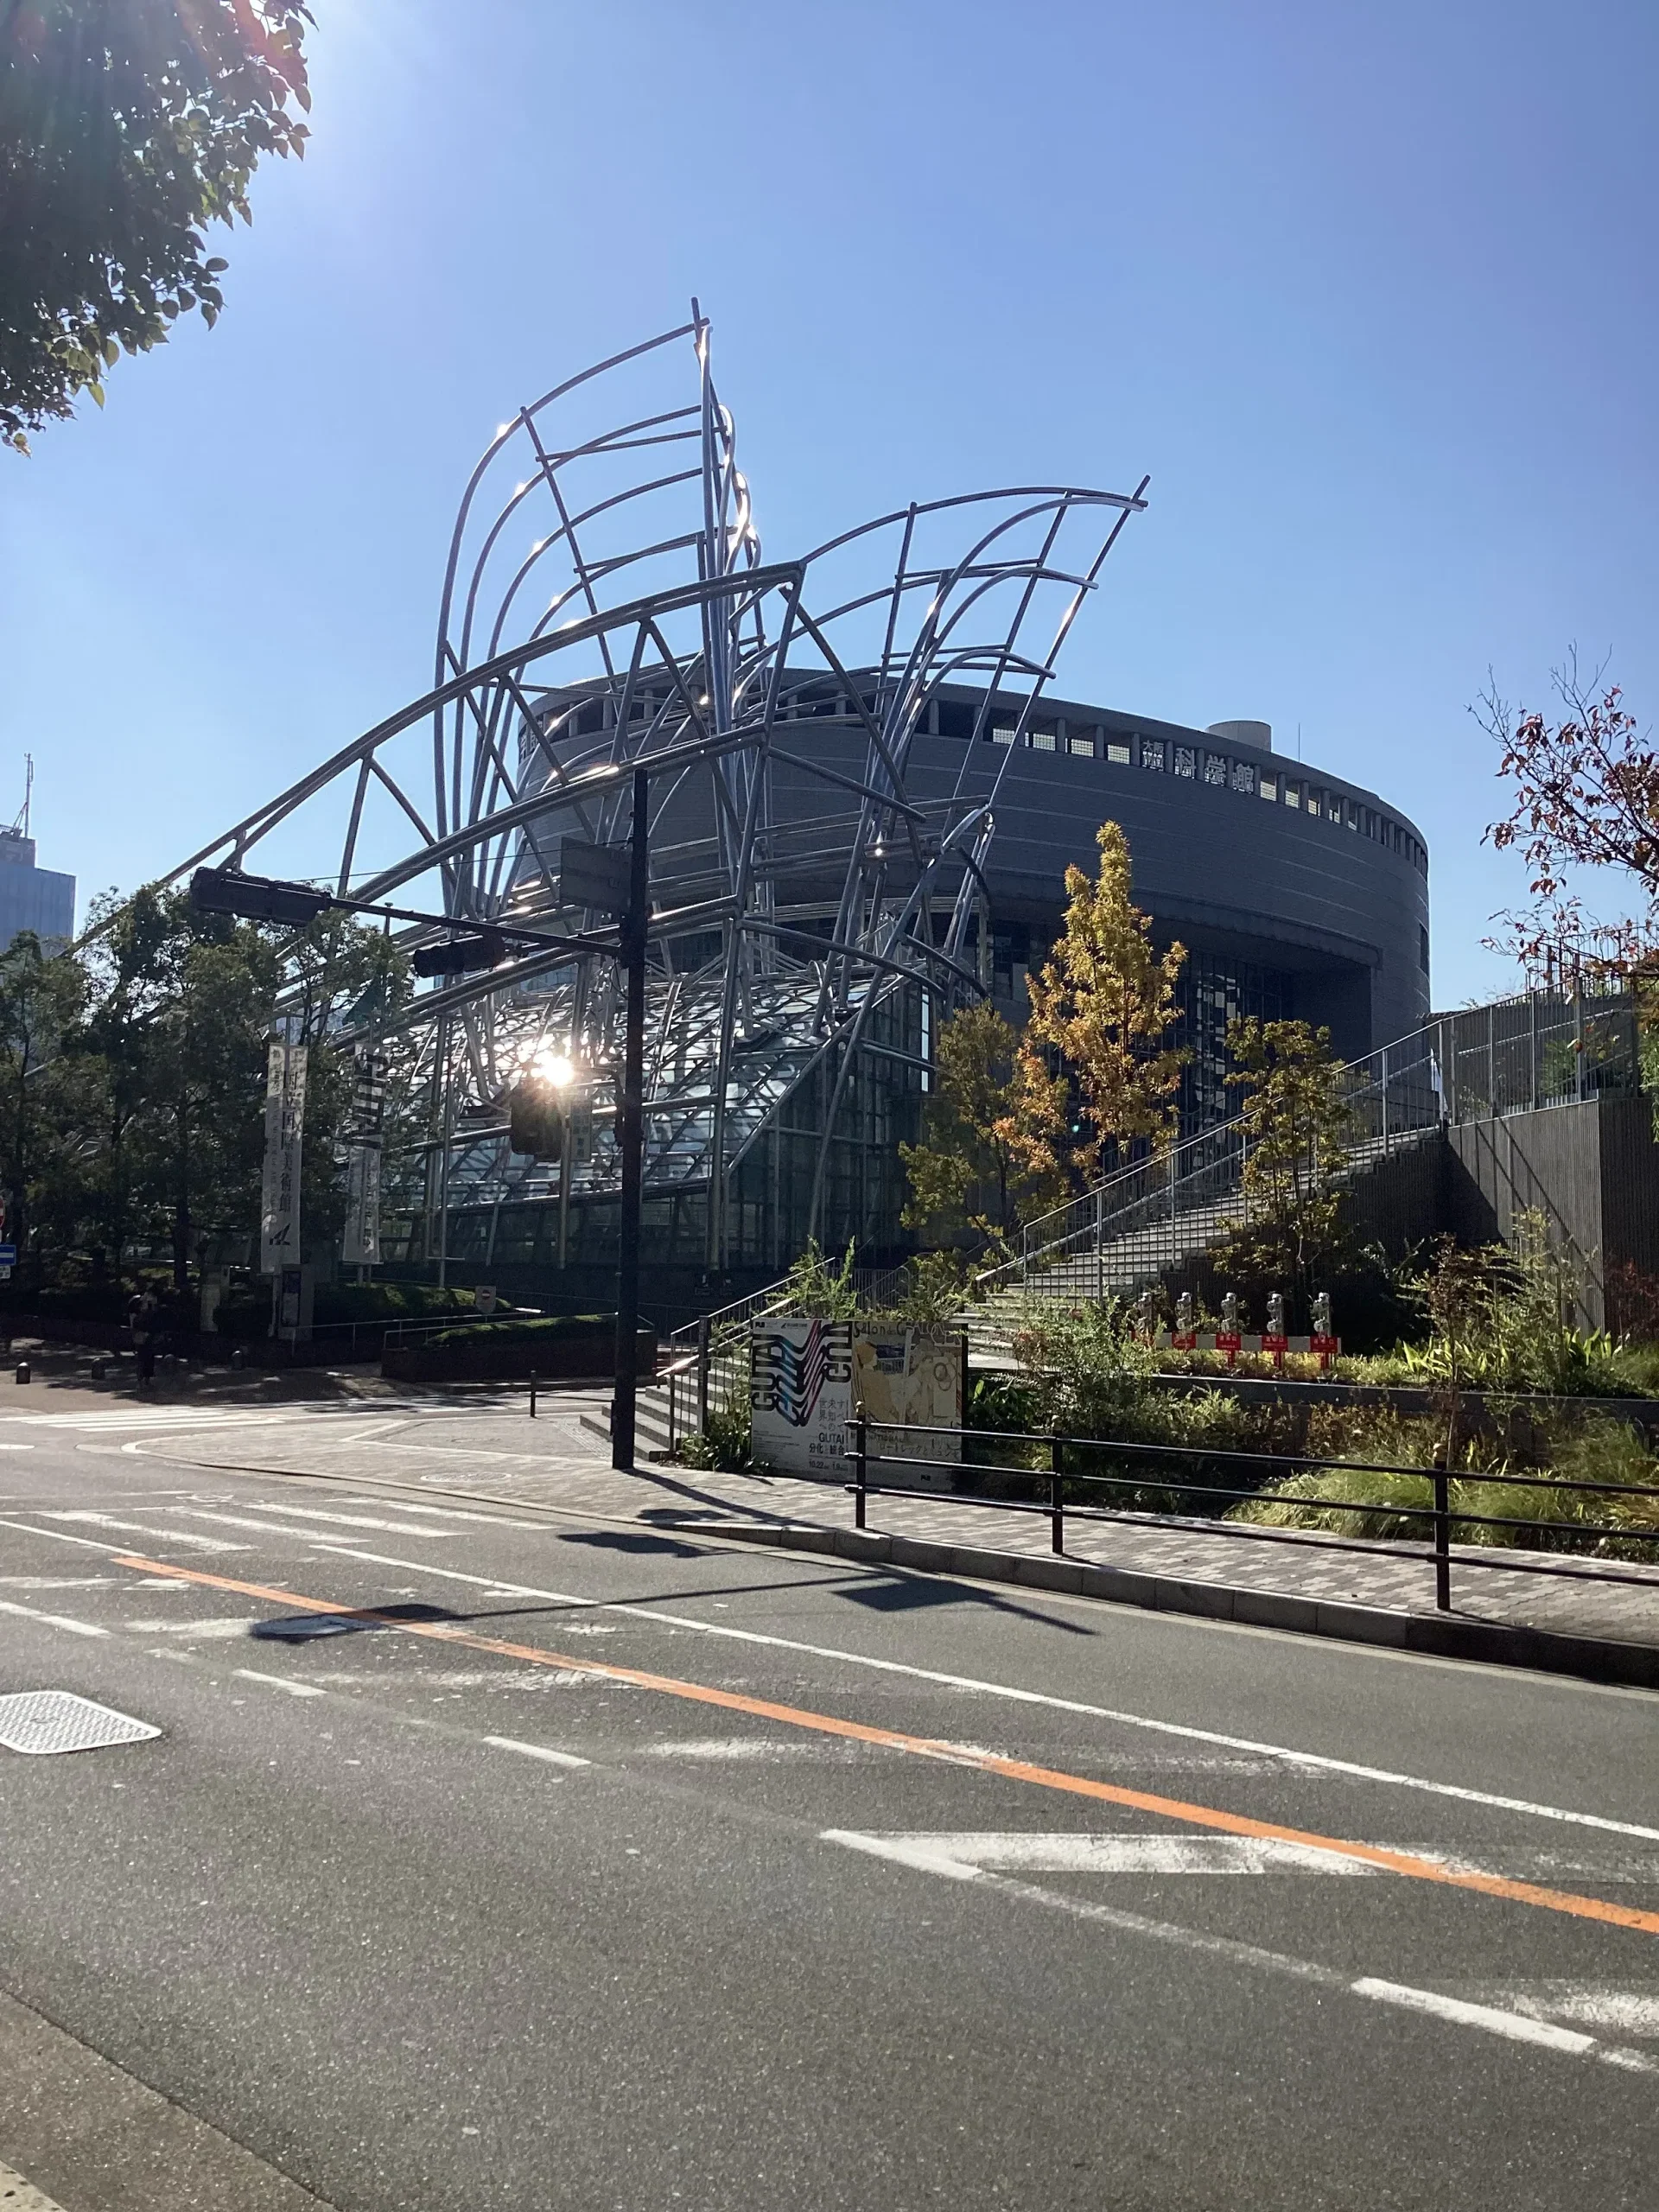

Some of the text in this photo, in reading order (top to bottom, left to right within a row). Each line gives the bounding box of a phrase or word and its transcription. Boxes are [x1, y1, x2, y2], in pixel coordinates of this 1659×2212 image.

[1175, 747, 1254, 793] 科学館
[818, 1432, 845, 1445] GUTAI
